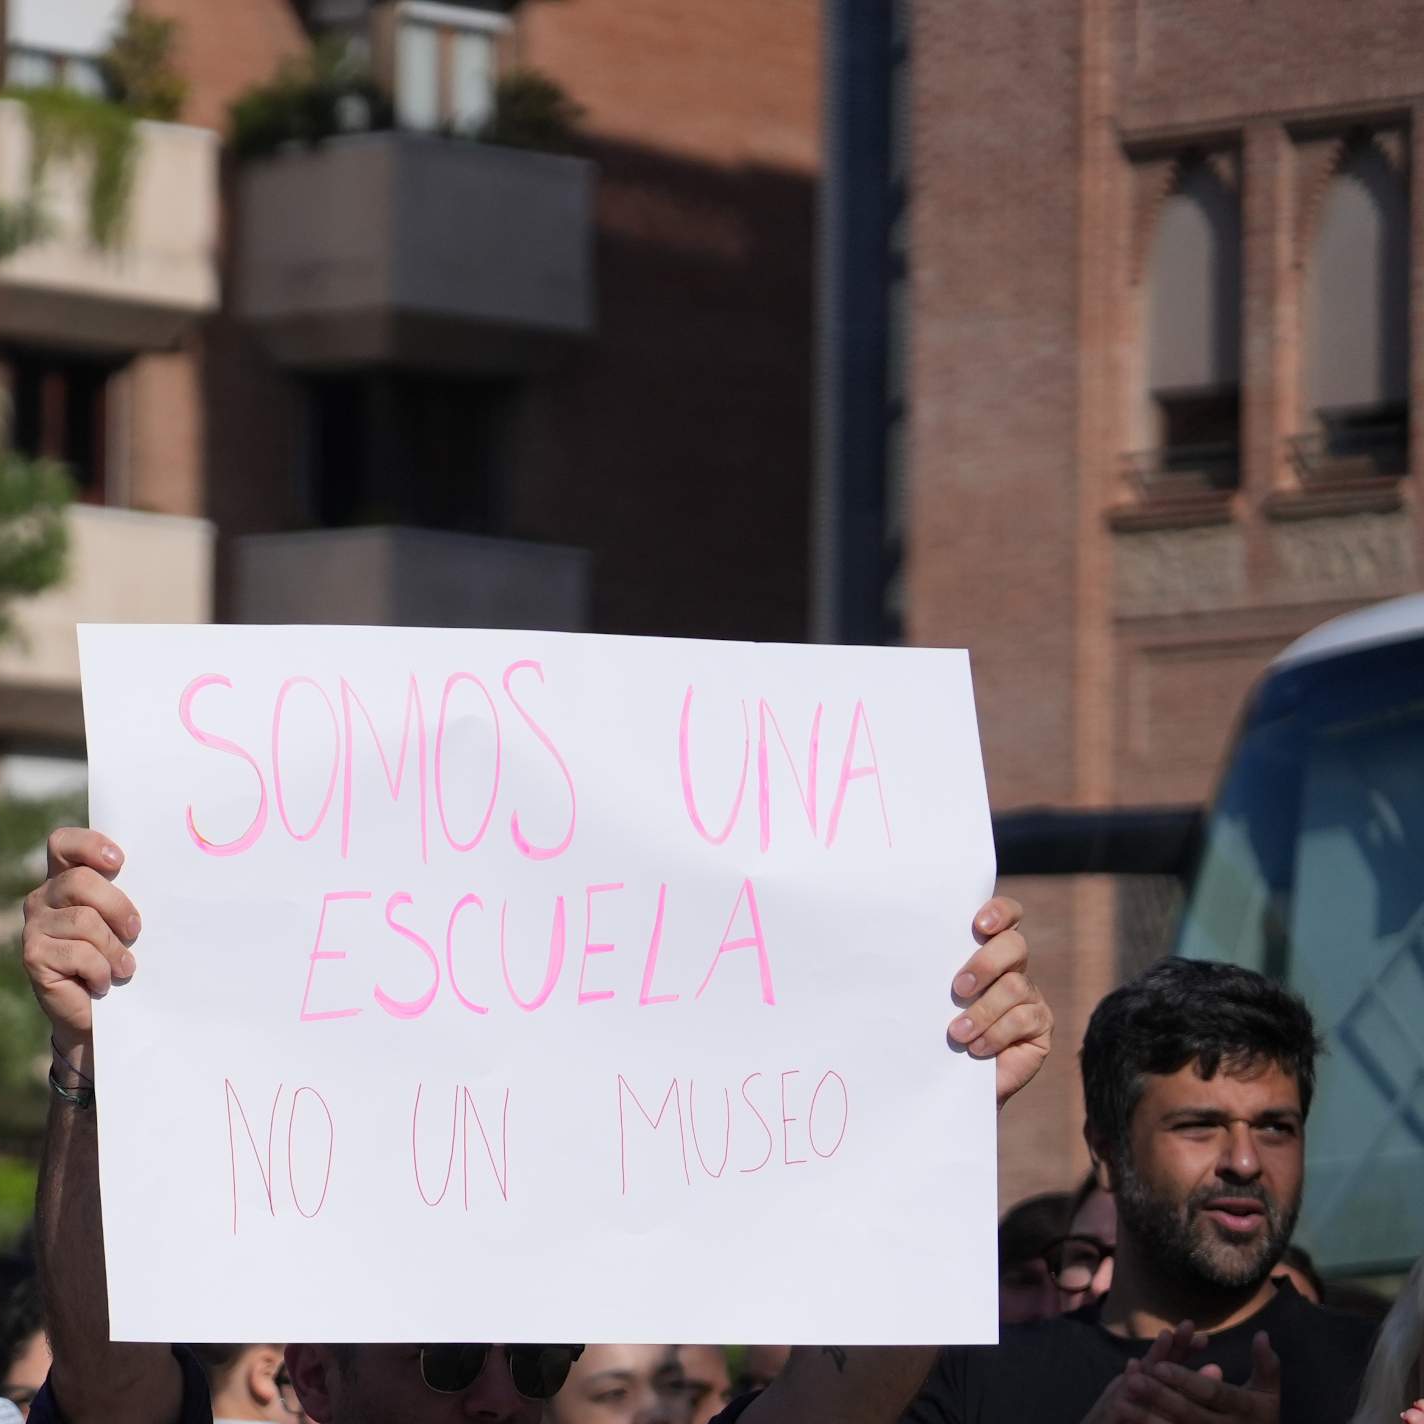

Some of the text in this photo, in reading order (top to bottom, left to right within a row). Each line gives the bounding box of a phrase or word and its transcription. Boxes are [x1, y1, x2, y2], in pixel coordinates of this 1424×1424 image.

[179, 659, 893, 864] SOMOS UNA
[300, 878, 776, 1021] ESCUELA
[224, 1070, 848, 1235] NO UN MUSEO
